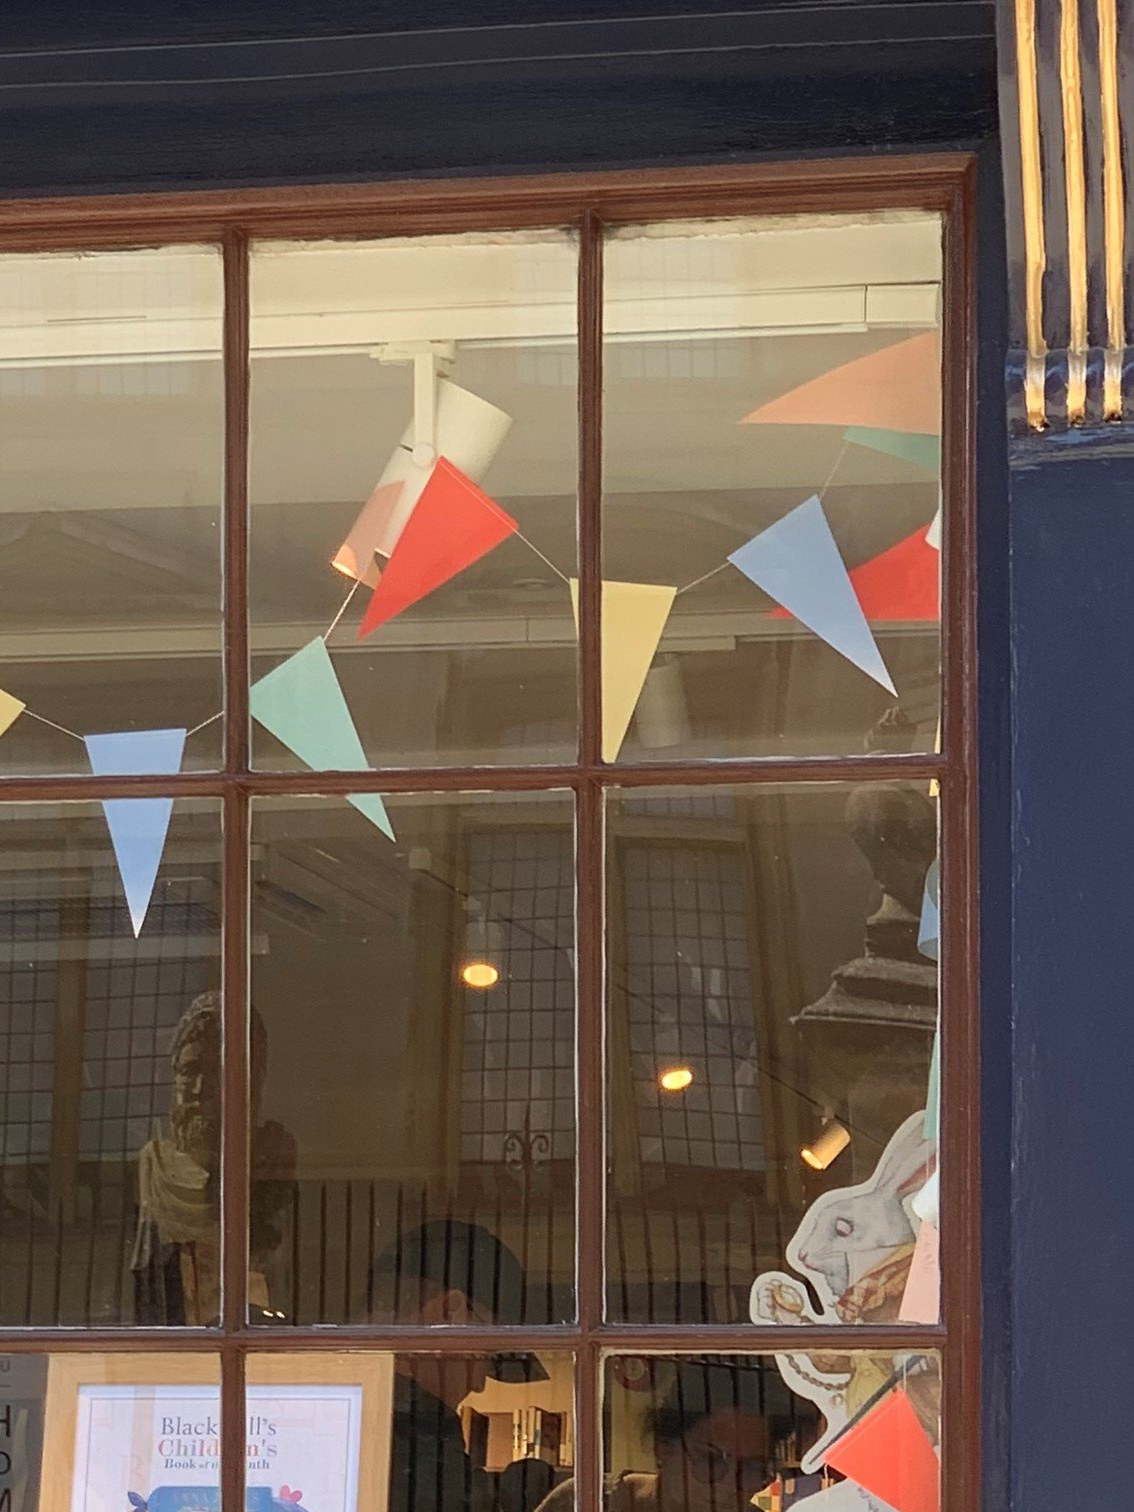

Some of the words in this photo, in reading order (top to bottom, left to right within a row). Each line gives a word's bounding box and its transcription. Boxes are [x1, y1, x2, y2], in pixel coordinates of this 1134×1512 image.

[161, 1416, 277, 1436] Blackll's
[157, 1438, 278, 1457] Childn's
[165, 1459, 196, 1469] Book
[248, 1459, 270, 1470] nth
